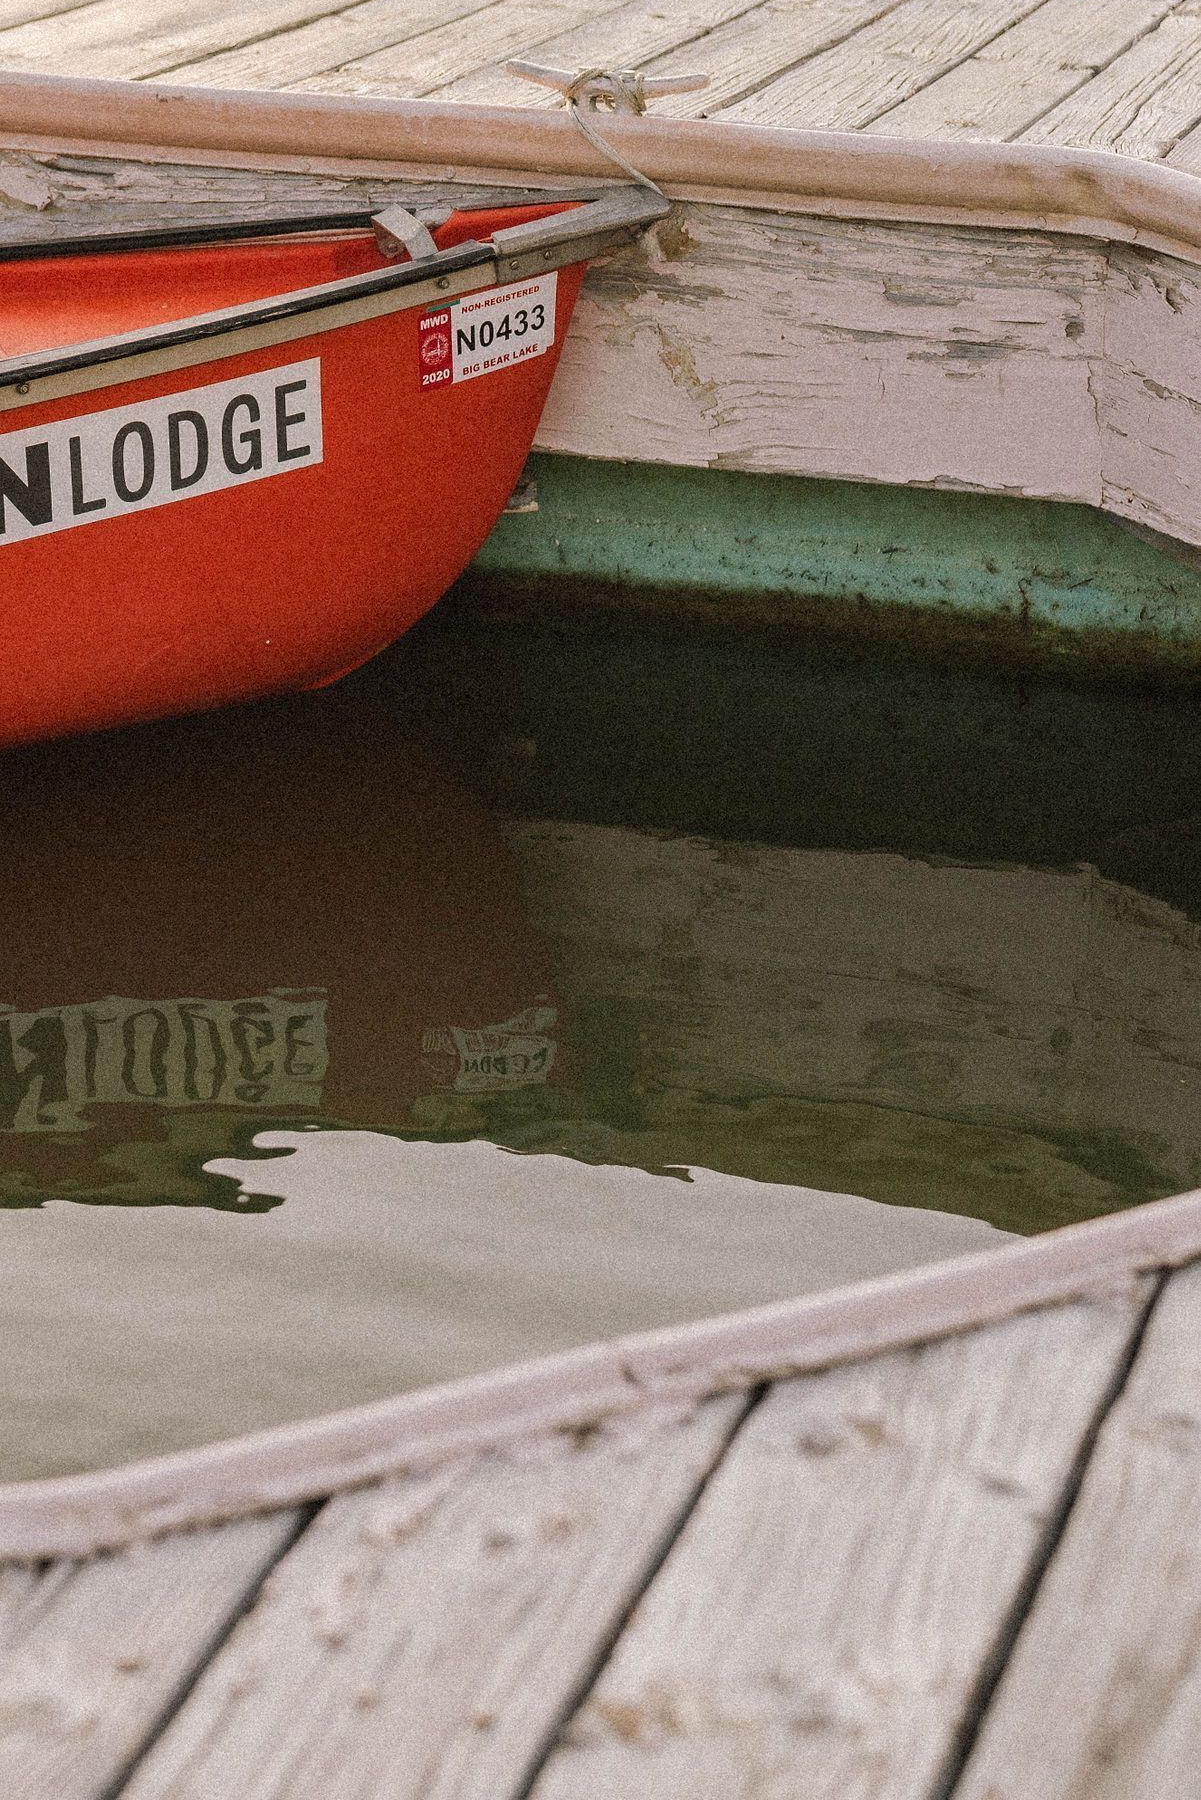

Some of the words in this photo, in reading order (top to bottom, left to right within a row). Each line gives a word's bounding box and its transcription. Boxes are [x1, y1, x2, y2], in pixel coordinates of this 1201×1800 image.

[461, 285, 540, 314] NON-REGISTERED
[420, 314, 449, 330] MWD
[456, 304, 545, 355] N0433
[462, 363, 480, 376] BIG
[483, 354, 510, 369] BEAR
[513, 343, 539, 359] LAKE
[421, 368, 450, 385] 2020
